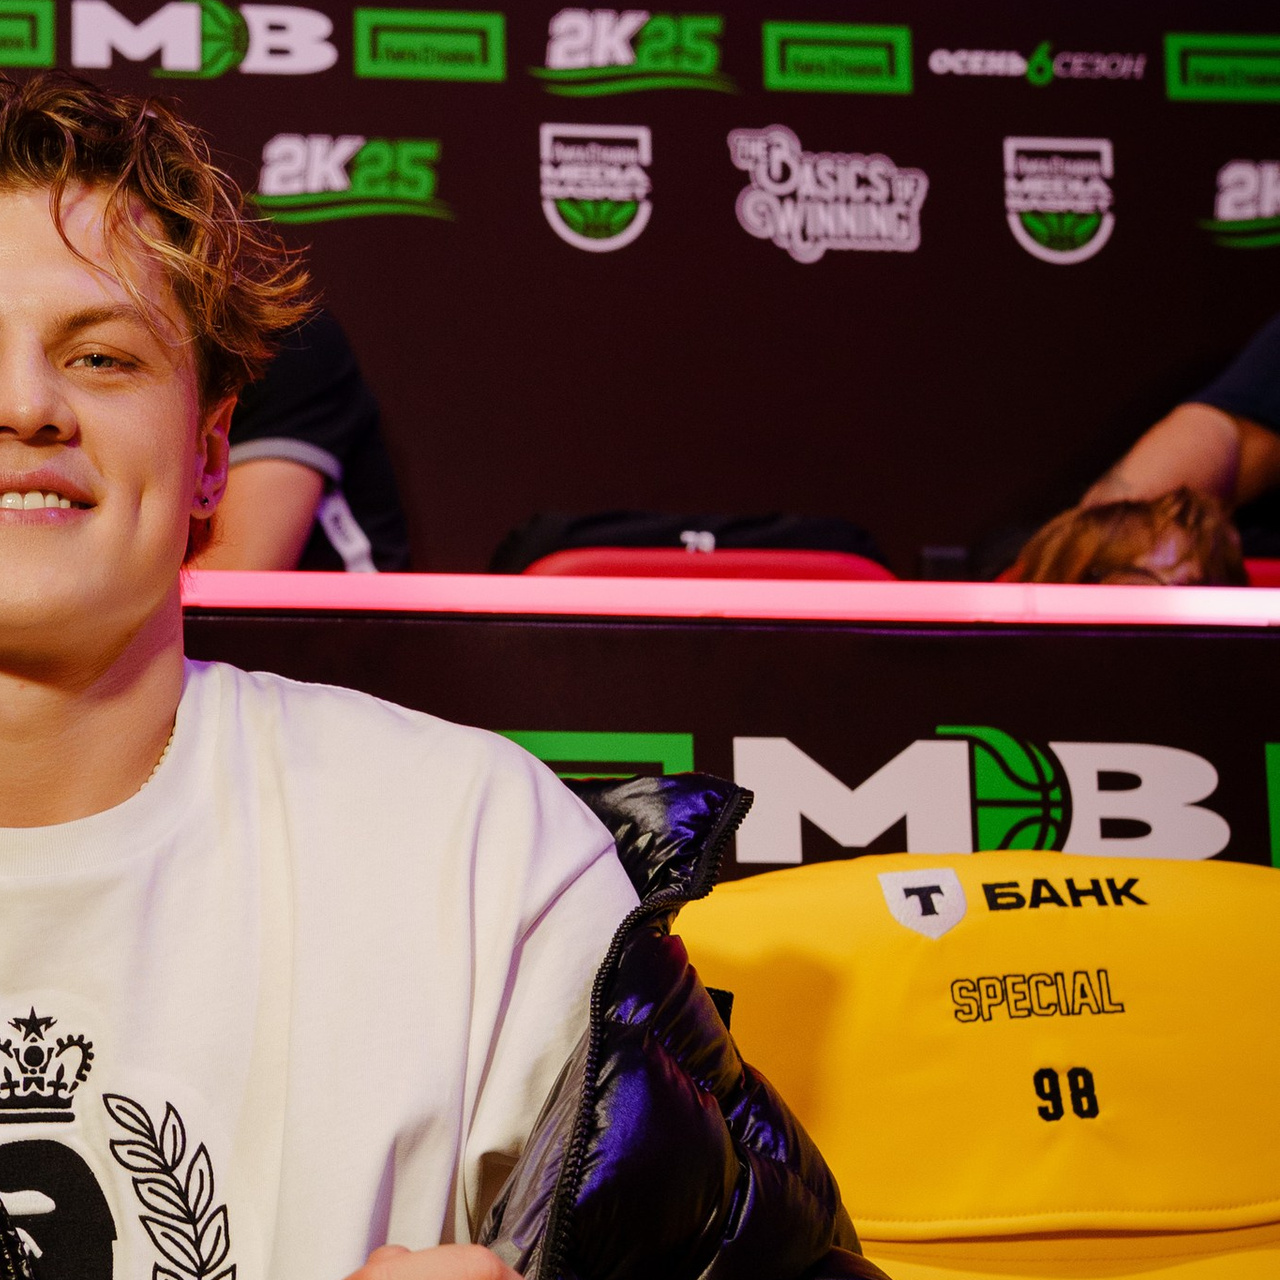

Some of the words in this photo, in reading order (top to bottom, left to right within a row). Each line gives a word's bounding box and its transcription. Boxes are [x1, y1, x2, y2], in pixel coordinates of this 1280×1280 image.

[545, 8, 722, 74] 2K25
[258, 133, 441, 200] 2K25
[981, 877, 1149, 912] БАНК
[950, 968, 1126, 1023] SPECIAL
[1032, 1065, 1100, 1123] 98
